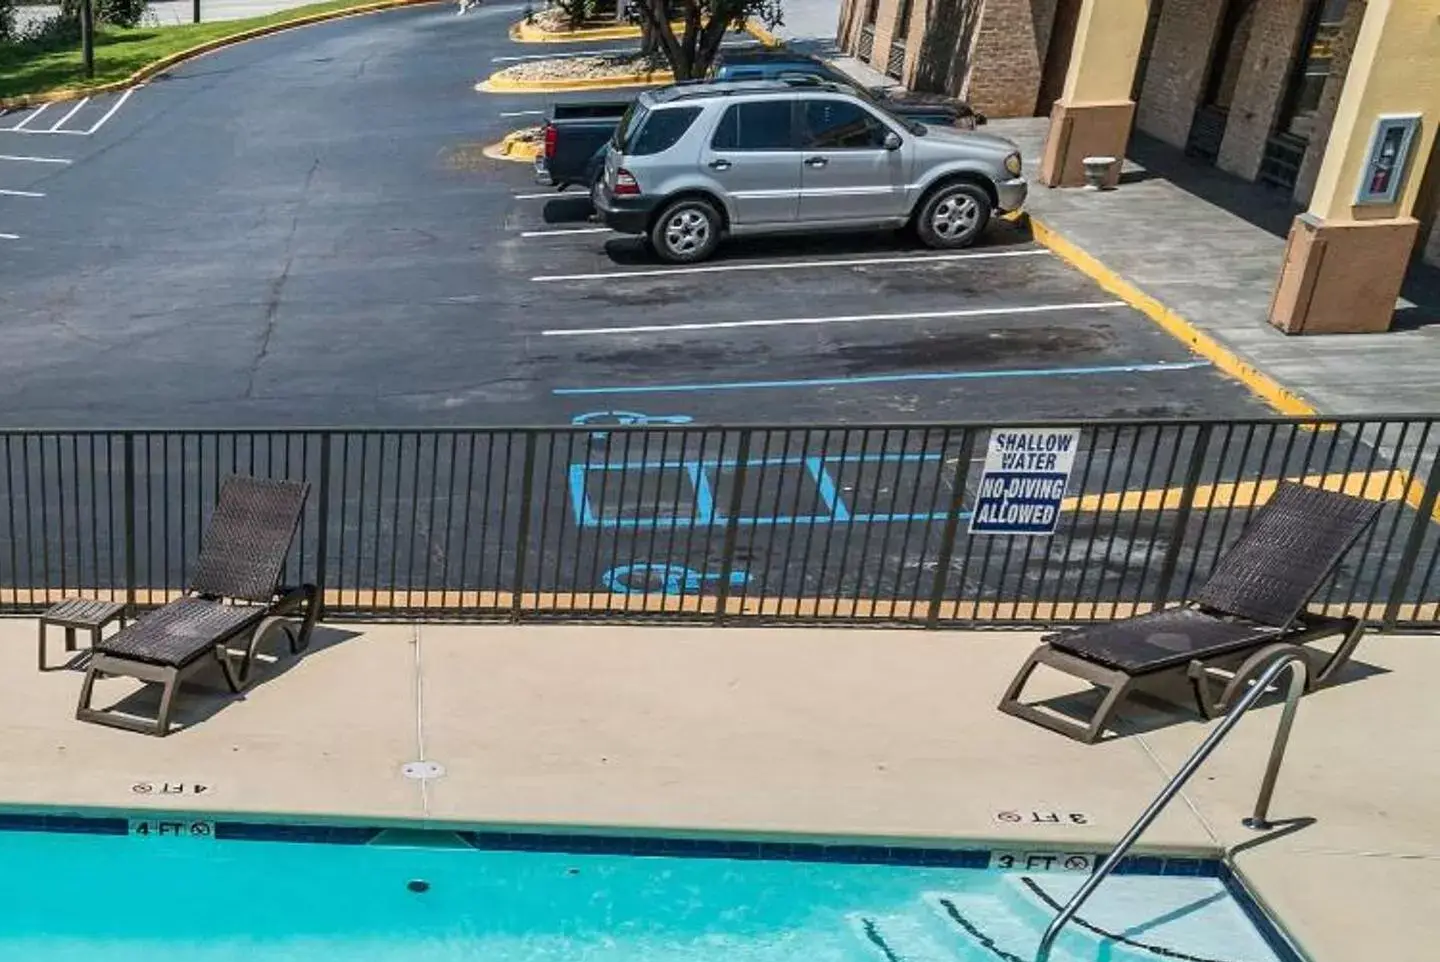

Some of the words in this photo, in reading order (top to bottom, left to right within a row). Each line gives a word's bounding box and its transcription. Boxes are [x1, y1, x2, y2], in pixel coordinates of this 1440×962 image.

[996, 434, 1073, 452] SHALLOW
[1001, 453, 1057, 470] WATER
[981, 478, 1005, 498] NO
[1008, 478, 1064, 500] DIVING
[977, 503, 1055, 524] ALLOWED
[160, 783, 184, 794] FT
[194, 784, 209, 794] 4
[1032, 811, 1059, 823] FT
[136, 822, 150, 836] 4
[159, 822, 185, 836] FT
[998, 854, 1014, 869] 3
[1026, 855, 1057, 870] FT
